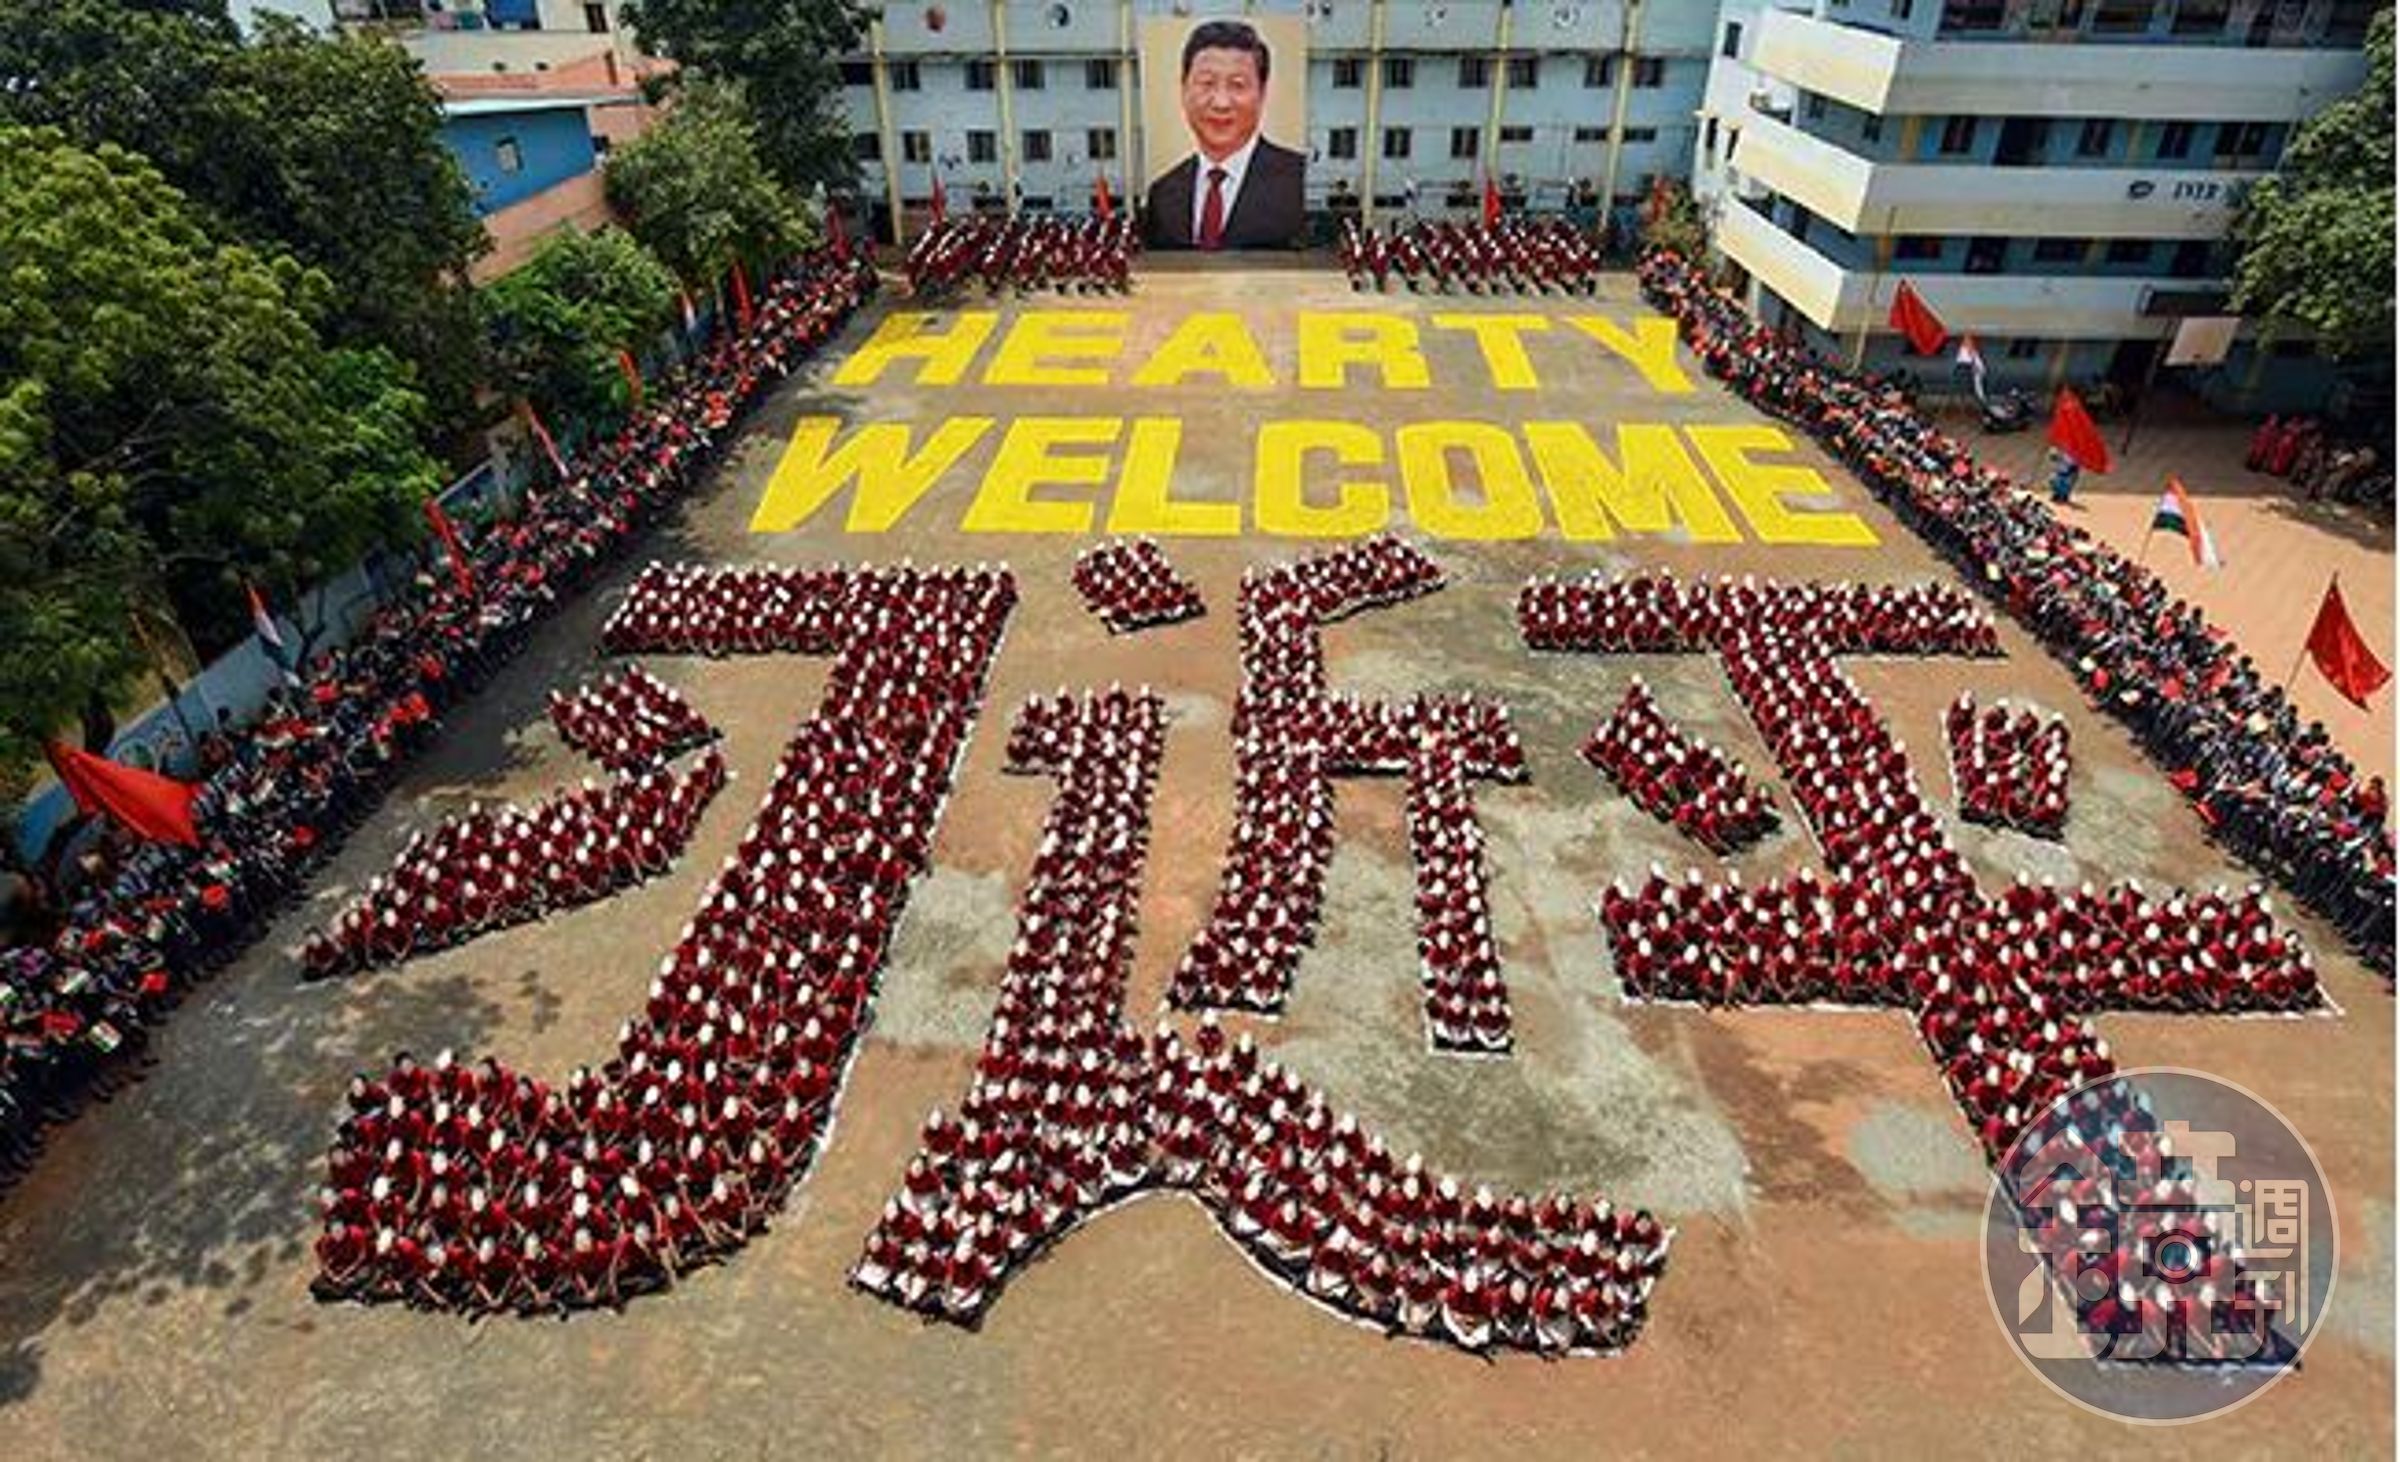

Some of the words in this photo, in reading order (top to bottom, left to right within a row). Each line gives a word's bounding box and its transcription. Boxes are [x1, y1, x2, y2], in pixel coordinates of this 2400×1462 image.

[832, 308, 1697, 393] HEARTY
[750, 413, 1880, 547] WELCOME
[302, 533, 2338, 1372] 习近平
